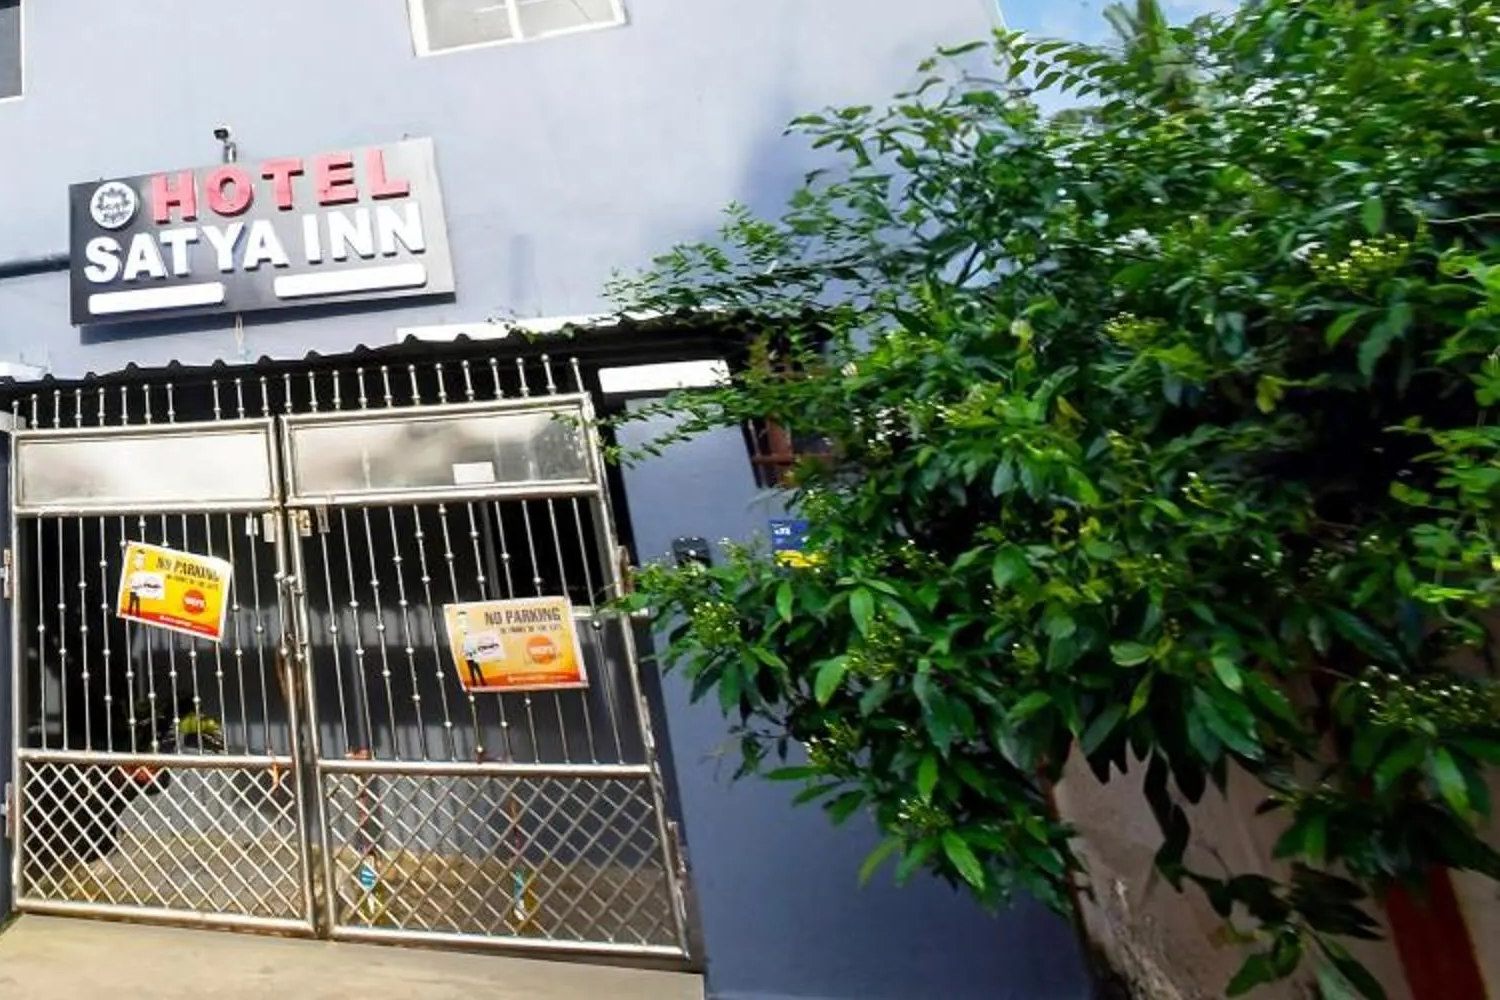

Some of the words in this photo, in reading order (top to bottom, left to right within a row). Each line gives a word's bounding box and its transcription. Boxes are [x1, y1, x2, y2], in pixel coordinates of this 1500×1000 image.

[149, 148, 411, 225] HOTEL
[84, 219, 289, 284] SATYA
[302, 201, 426, 265] INN
[484, 611, 503, 626] NO
[505, 607, 562, 625] PARKING
